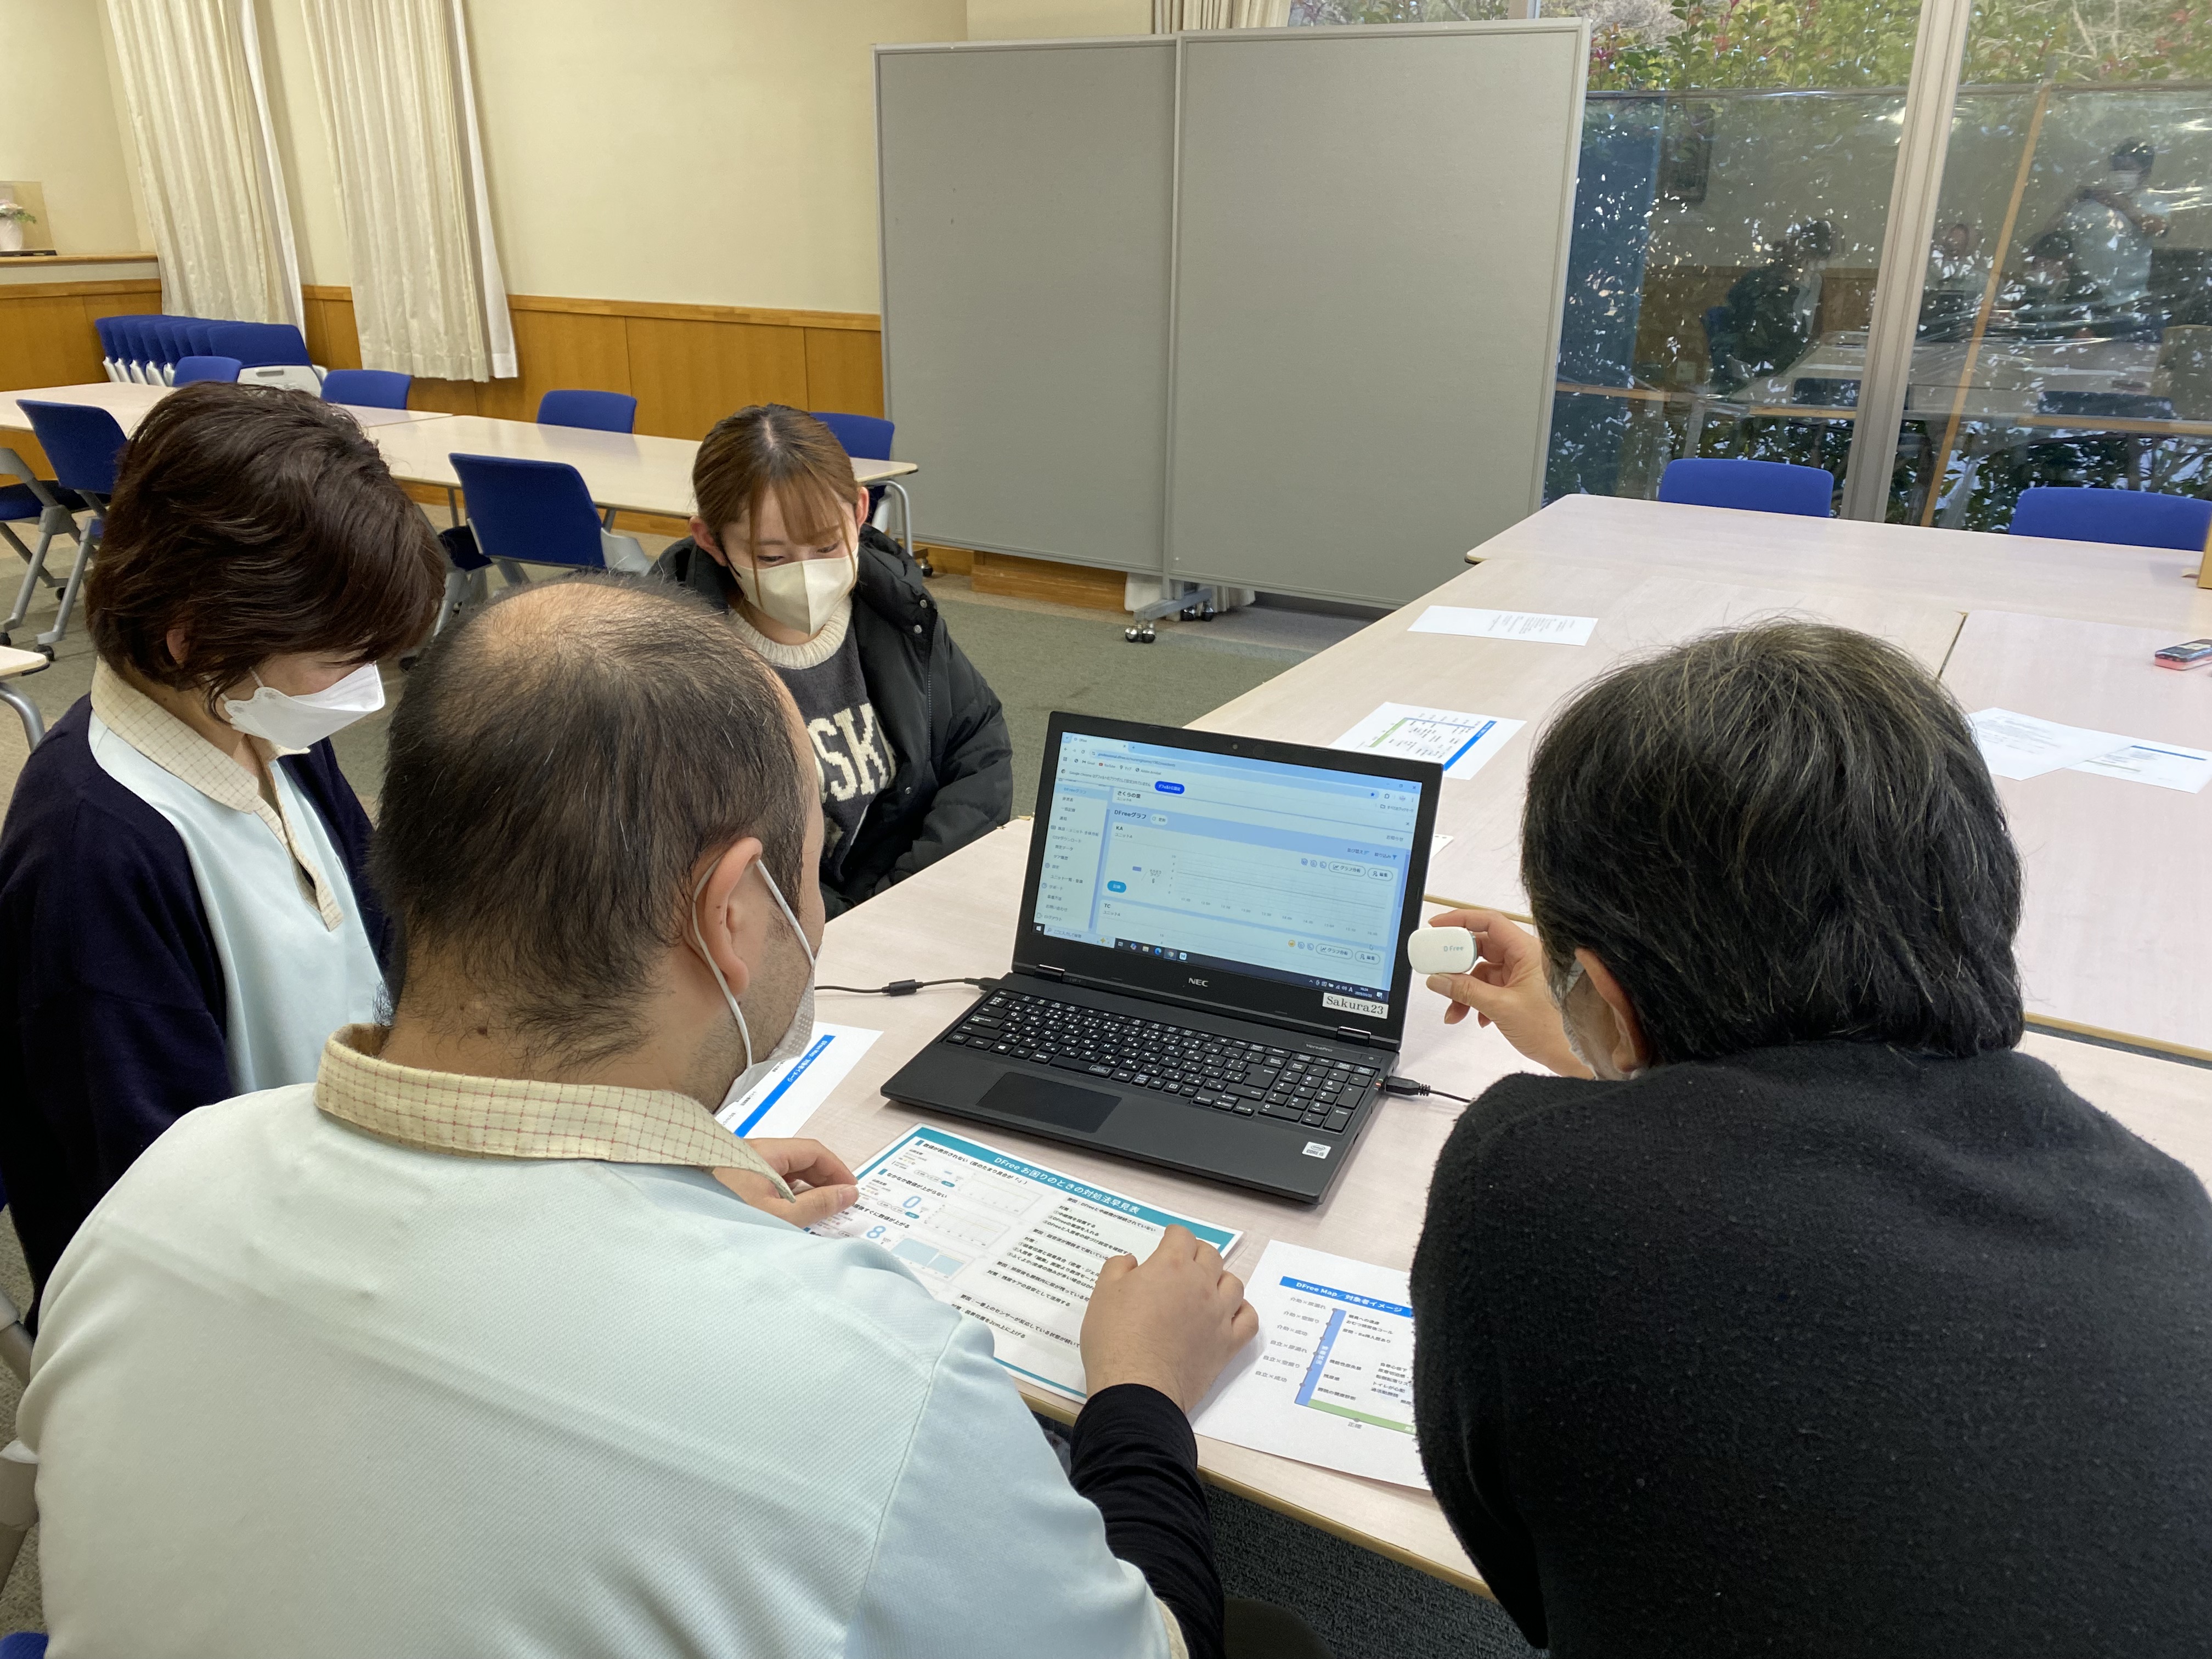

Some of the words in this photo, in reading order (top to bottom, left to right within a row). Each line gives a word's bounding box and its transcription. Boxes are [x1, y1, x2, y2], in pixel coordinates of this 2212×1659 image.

[1117, 791, 1141, 799] さくらの里
[1114, 810, 1147, 820] DFreeグラフ
[1052, 835, 1082, 843] CSVダウンロード
[1327, 948, 1348, 956] グラフ分析
[1188, 977, 1209, 987] NEC
[1326, 996, 1384, 1015] Sakura23
[1306, 1043, 1333, 1052] VersaPro
[887, 1172, 947, 1199] なかなか数値が上がらない
[994, 1156, 1020, 1170] DFree
[1020, 1167, 1141, 1215] お困りのときの対処法早見表
[902, 1195, 922, 1209] 0
[853, 1203, 910, 1228] 尿後すぐに数値が上がる
[1067, 1197, 1156, 1232] 要因：DFreeと中継機が接続されていない
[866, 1226, 887, 1239] 8
[1048, 1215, 1099, 1237] ②DFreeの電源を入れる
[1296, 1282, 1319, 1292] DFree
[1277, 1324, 1308, 1336] 介助×成功
[1270, 1340, 1307, 1353] 自立×尿漏れ
[1255, 1370, 1288, 1383] 自立×成功
[1373, 1381, 1406, 1394] トイレが心配
